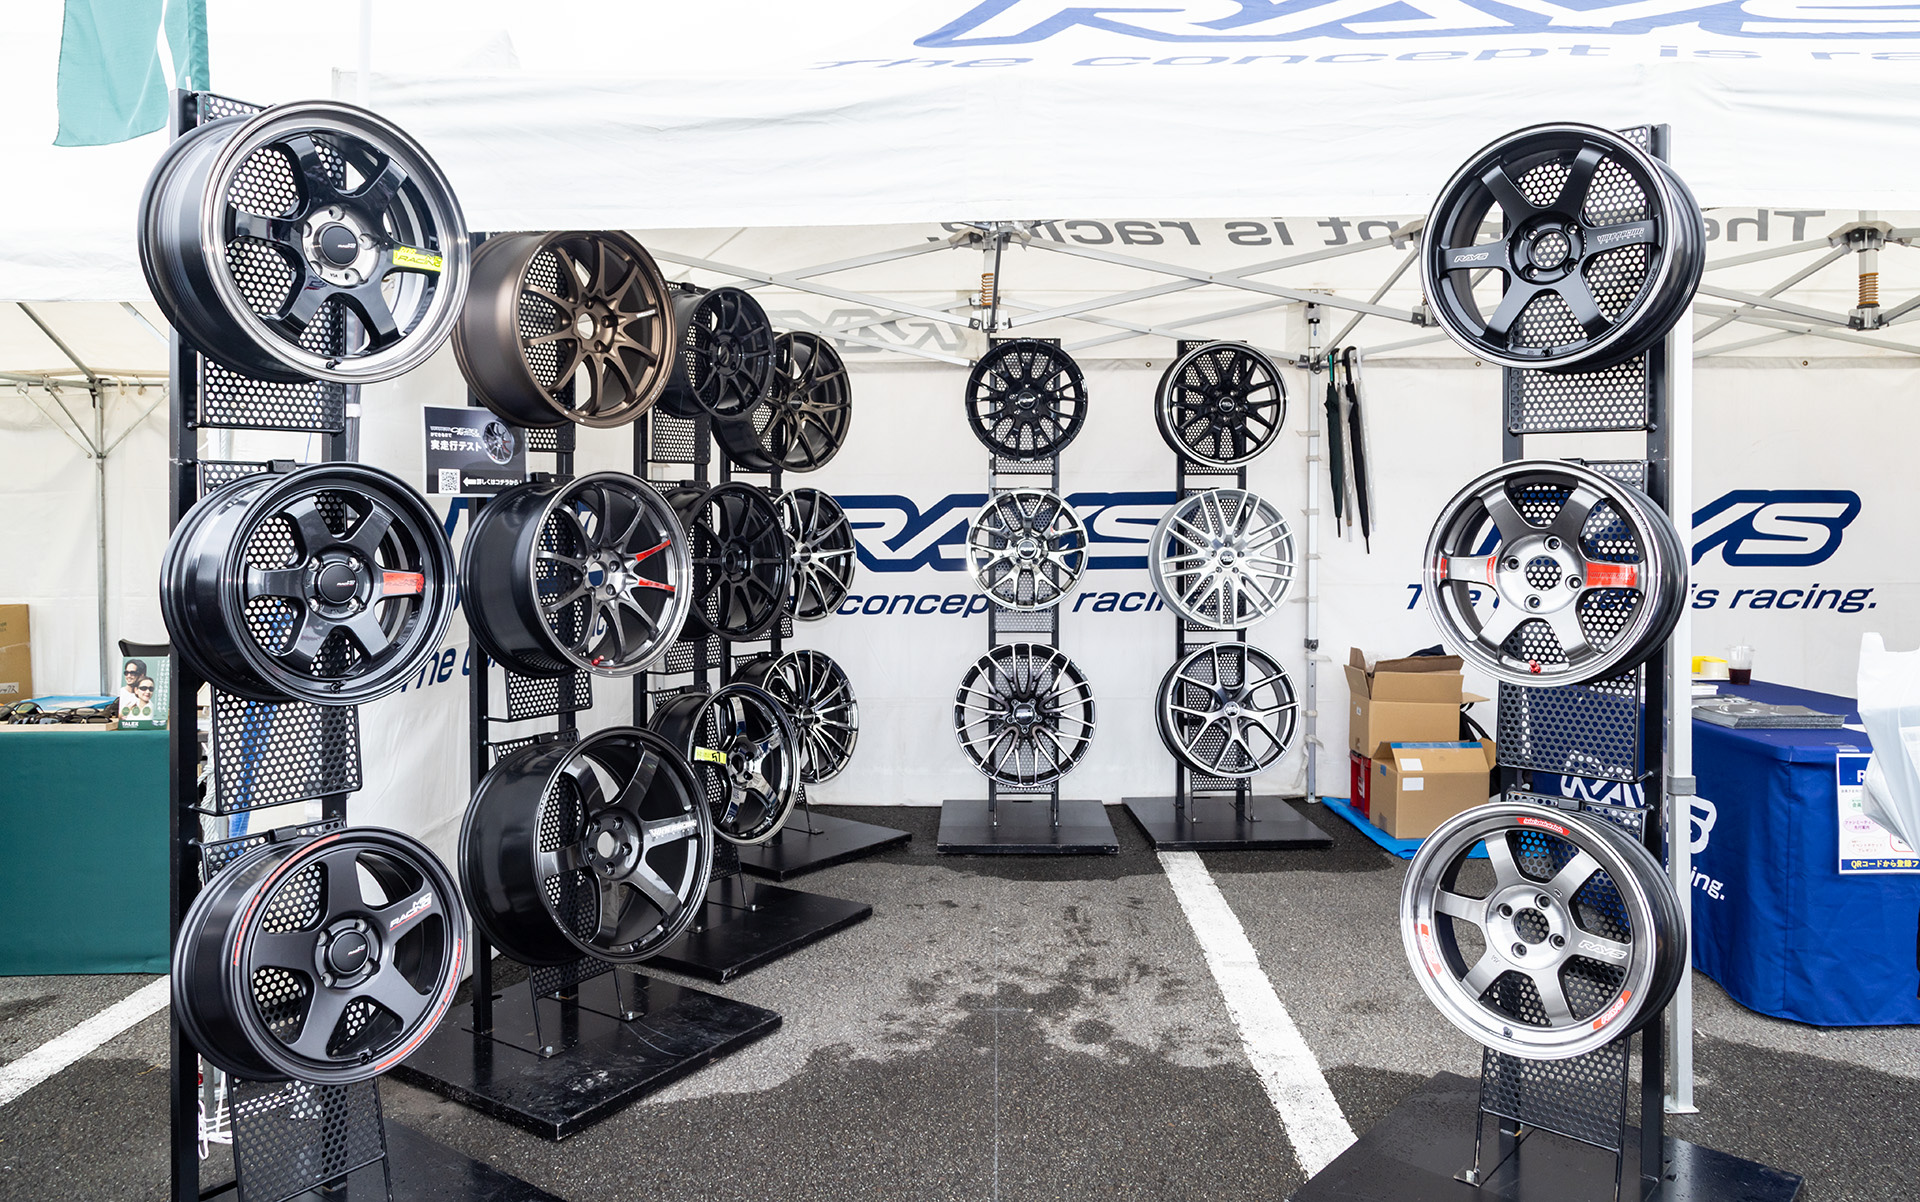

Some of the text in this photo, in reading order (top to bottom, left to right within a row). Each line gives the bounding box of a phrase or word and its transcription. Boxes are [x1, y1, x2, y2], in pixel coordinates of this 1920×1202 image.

[804, 58, 1034, 69] The
[1071, 45, 1613, 67] concept
[1660, 45, 1762, 59] is
[1454, 252, 1489, 263] RAYS
[430, 440, 482, 452] 実走行テスト
[837, 593, 990, 618] concep
[1729, 584, 1878, 614] racing.
[1578, 939, 1628, 960] RAYS
